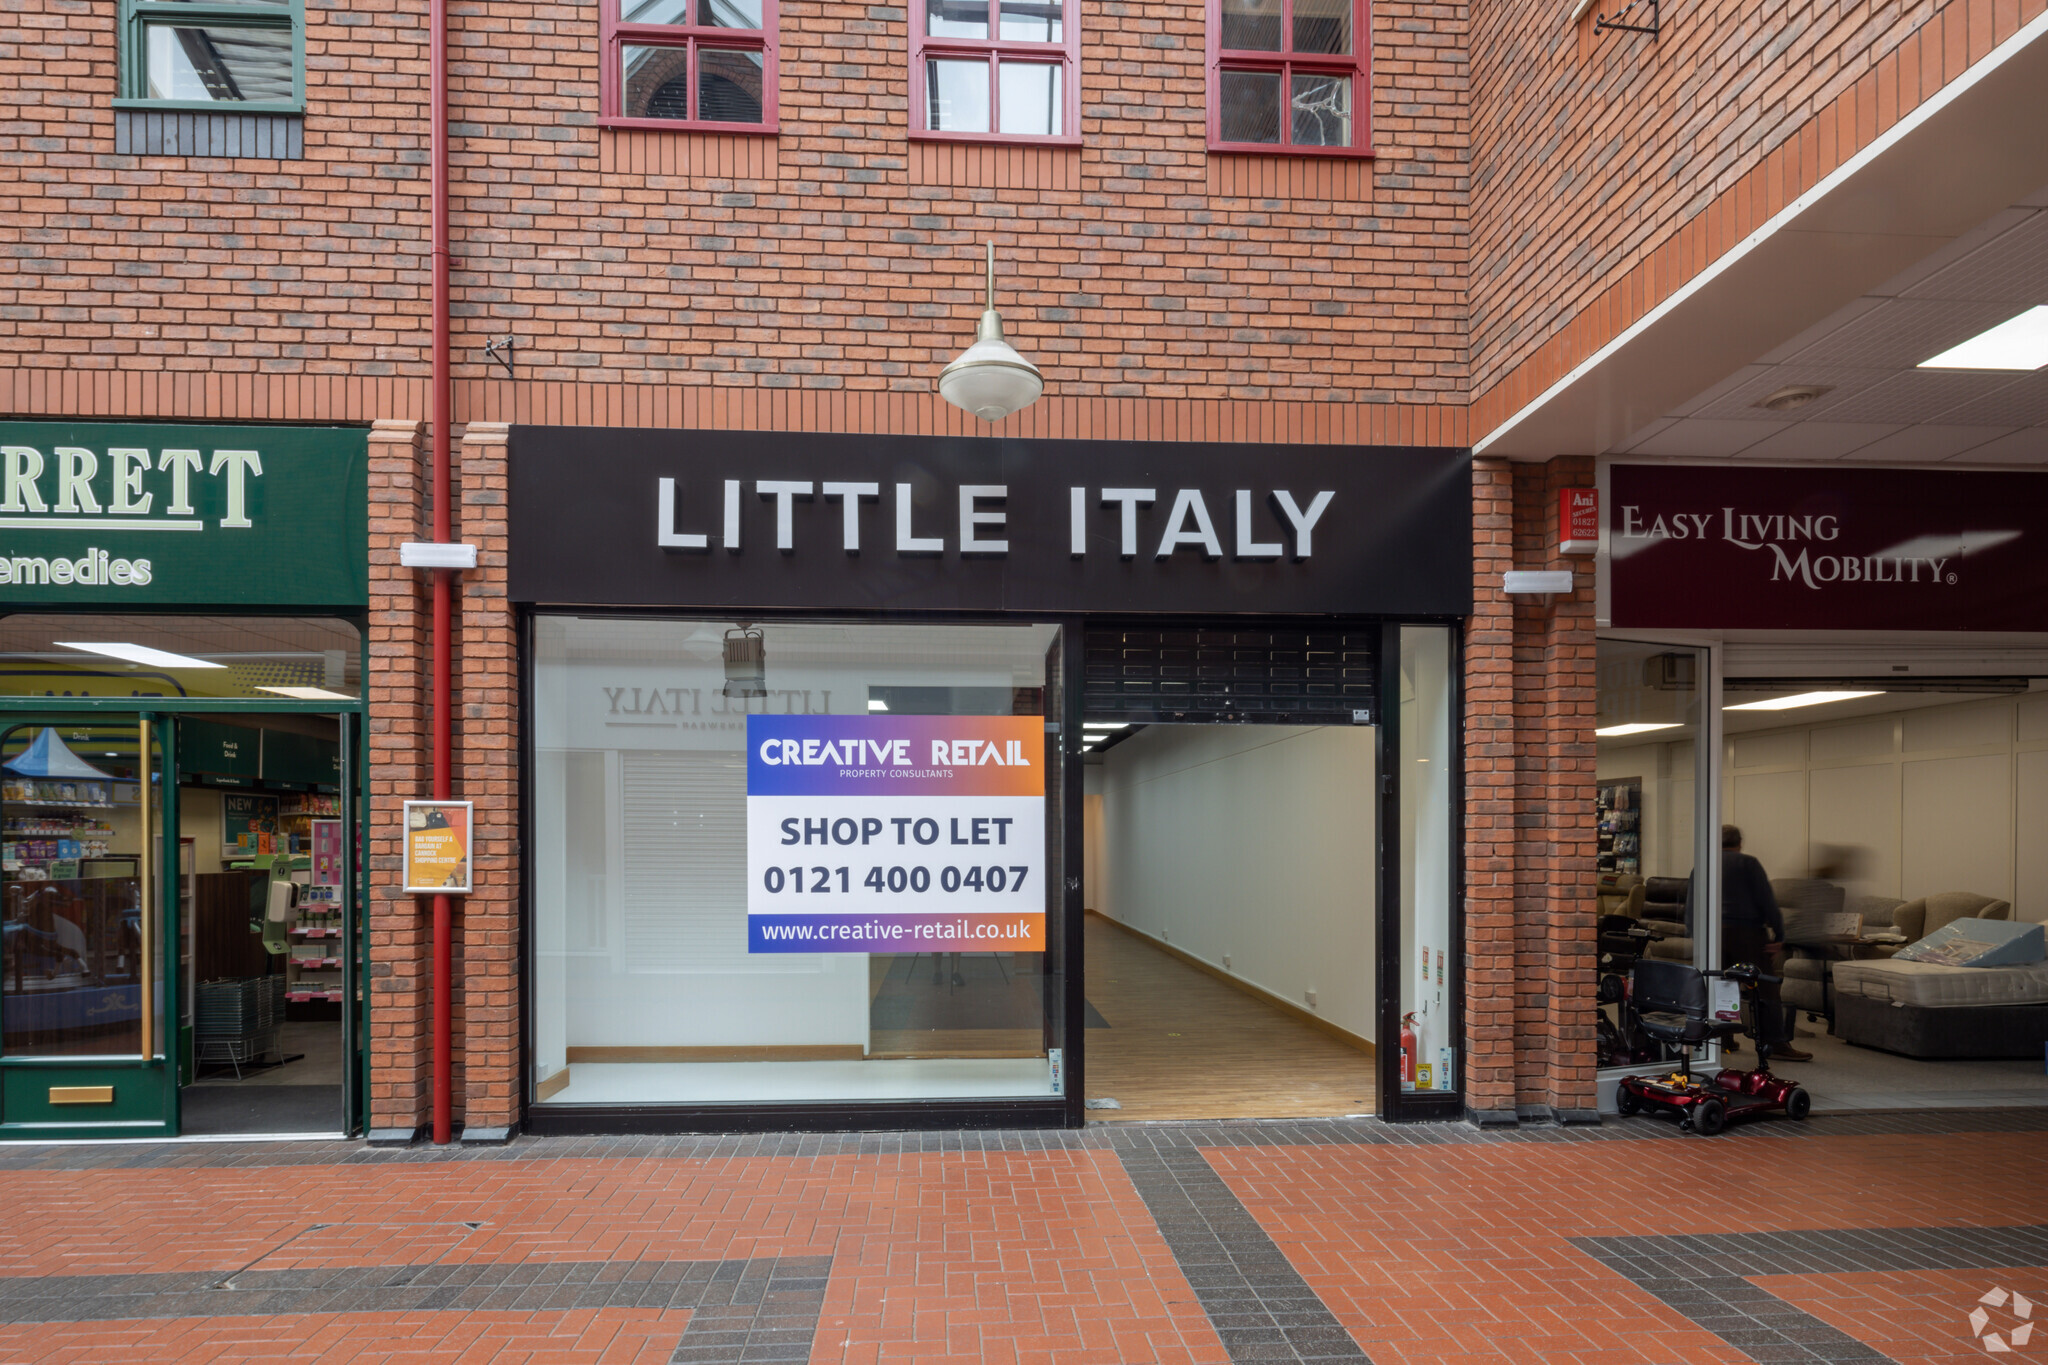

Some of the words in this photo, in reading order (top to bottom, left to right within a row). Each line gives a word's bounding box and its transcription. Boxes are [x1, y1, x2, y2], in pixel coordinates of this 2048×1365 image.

[1573, 493, 1594, 506] Ani
[657, 477, 1009, 554] LITTLE
[1070, 486, 1337, 559] ITALY
[1572, 518, 1596, 526] 01827
[1572, 528, 1596, 537] 62622
[760, 738, 913, 766] CREATIVE
[931, 740, 1031, 766] RETAIL
[839, 769, 887, 779] PROPERTY
[889, 769, 954, 779] CONSULTANTS
[228, 797, 253, 811] NEW
[780, 817, 883, 846] SHOP
[890, 817, 940, 846] TO
[950, 817, 1013, 846] LET
[763, 866, 850, 894] 0121
[864, 865, 931, 893] 400
[940, 865, 1029, 893] 0407
[762, 919, 1031, 940] www.creative-retail.co.uk
